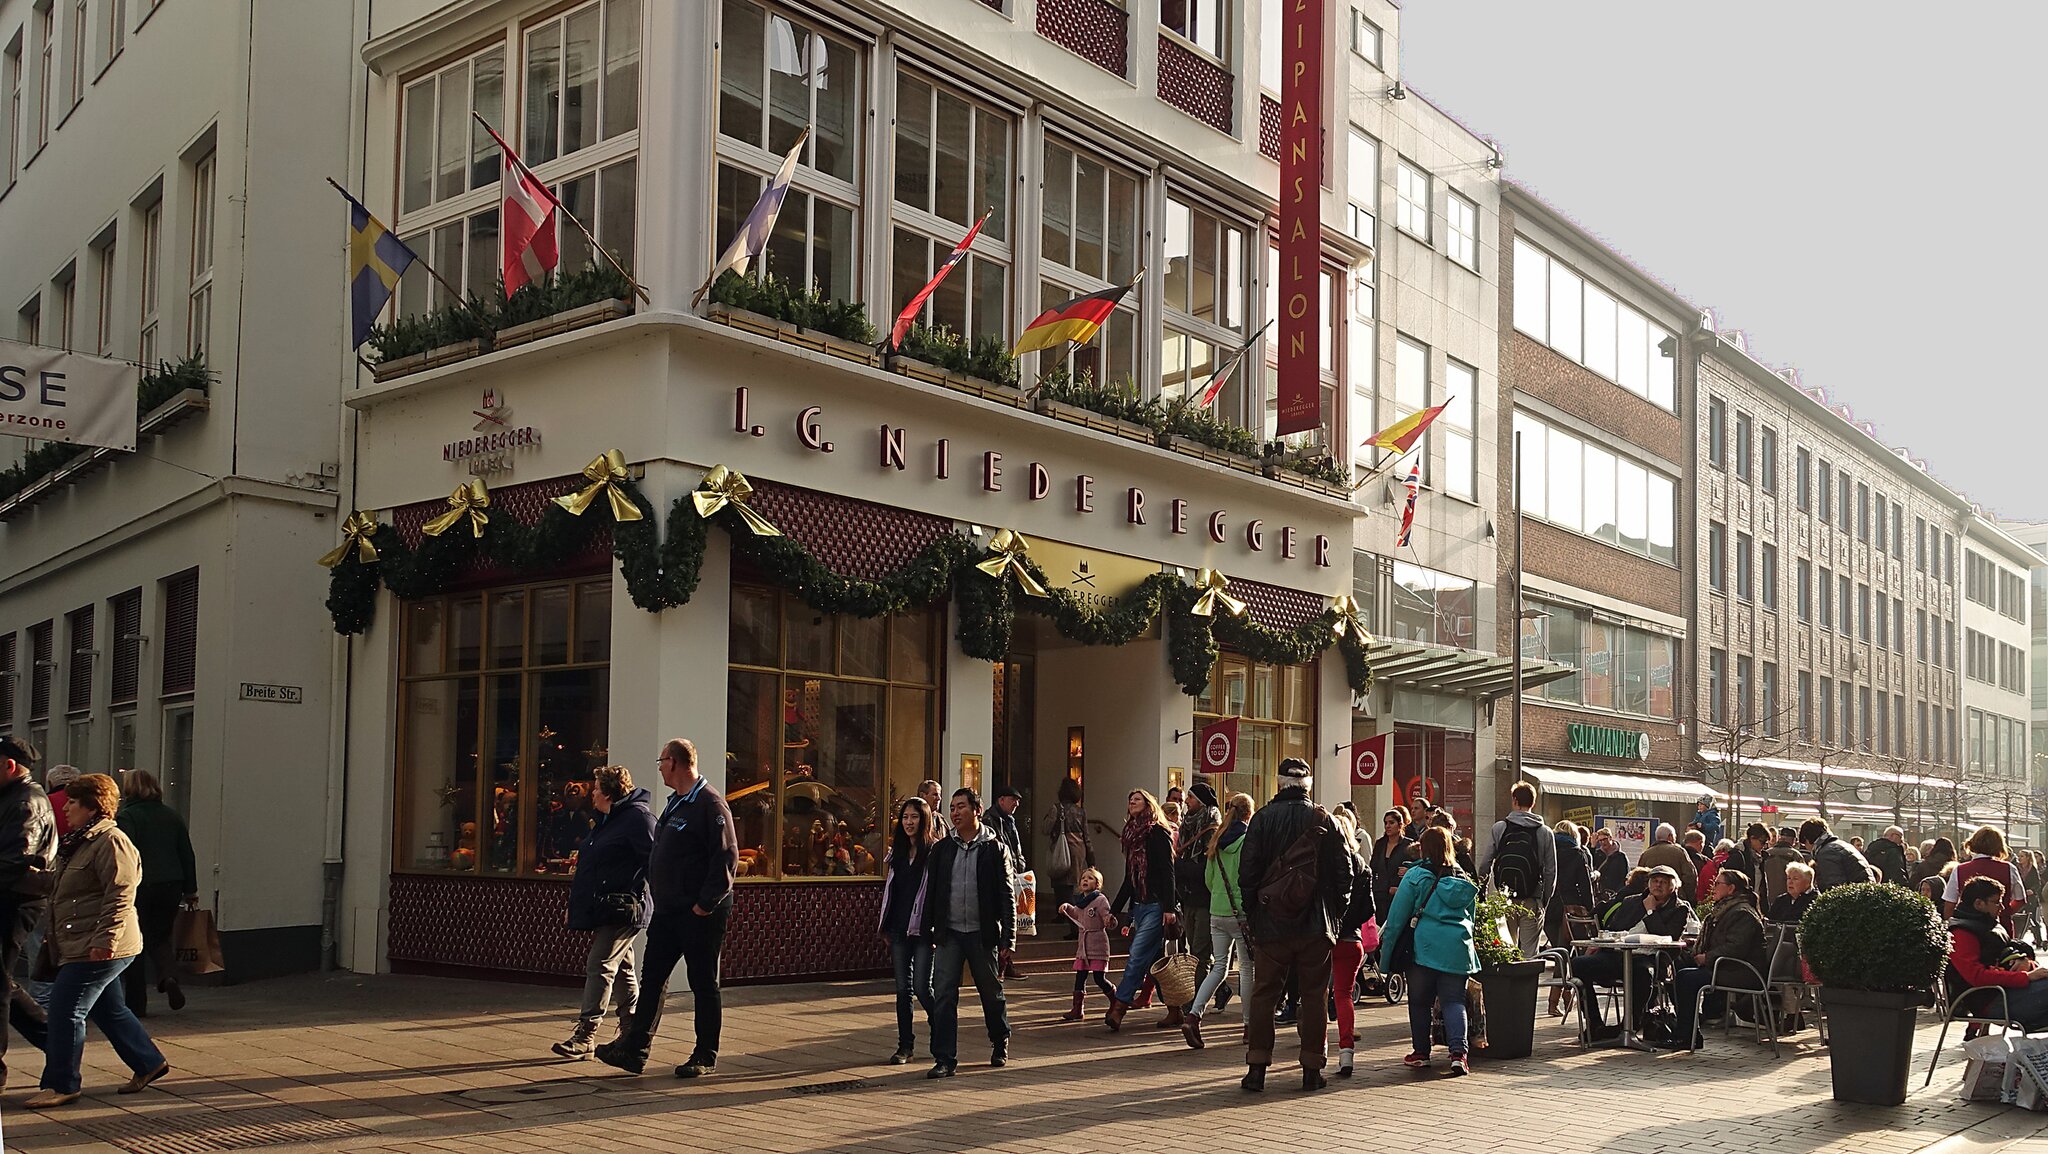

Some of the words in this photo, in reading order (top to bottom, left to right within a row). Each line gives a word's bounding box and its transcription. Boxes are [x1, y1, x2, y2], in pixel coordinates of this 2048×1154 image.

[443, 426, 534, 461] NIEDEREGGER
[735, 386, 765, 437] I.
[796, 406, 834, 452] G.
[880, 424, 1331, 567] NIEDEREGGER
[246, 684, 276, 698] Breite
[280, 687, 298, 700] Str.
[1571, 723, 1637, 759] SALAMANDER
